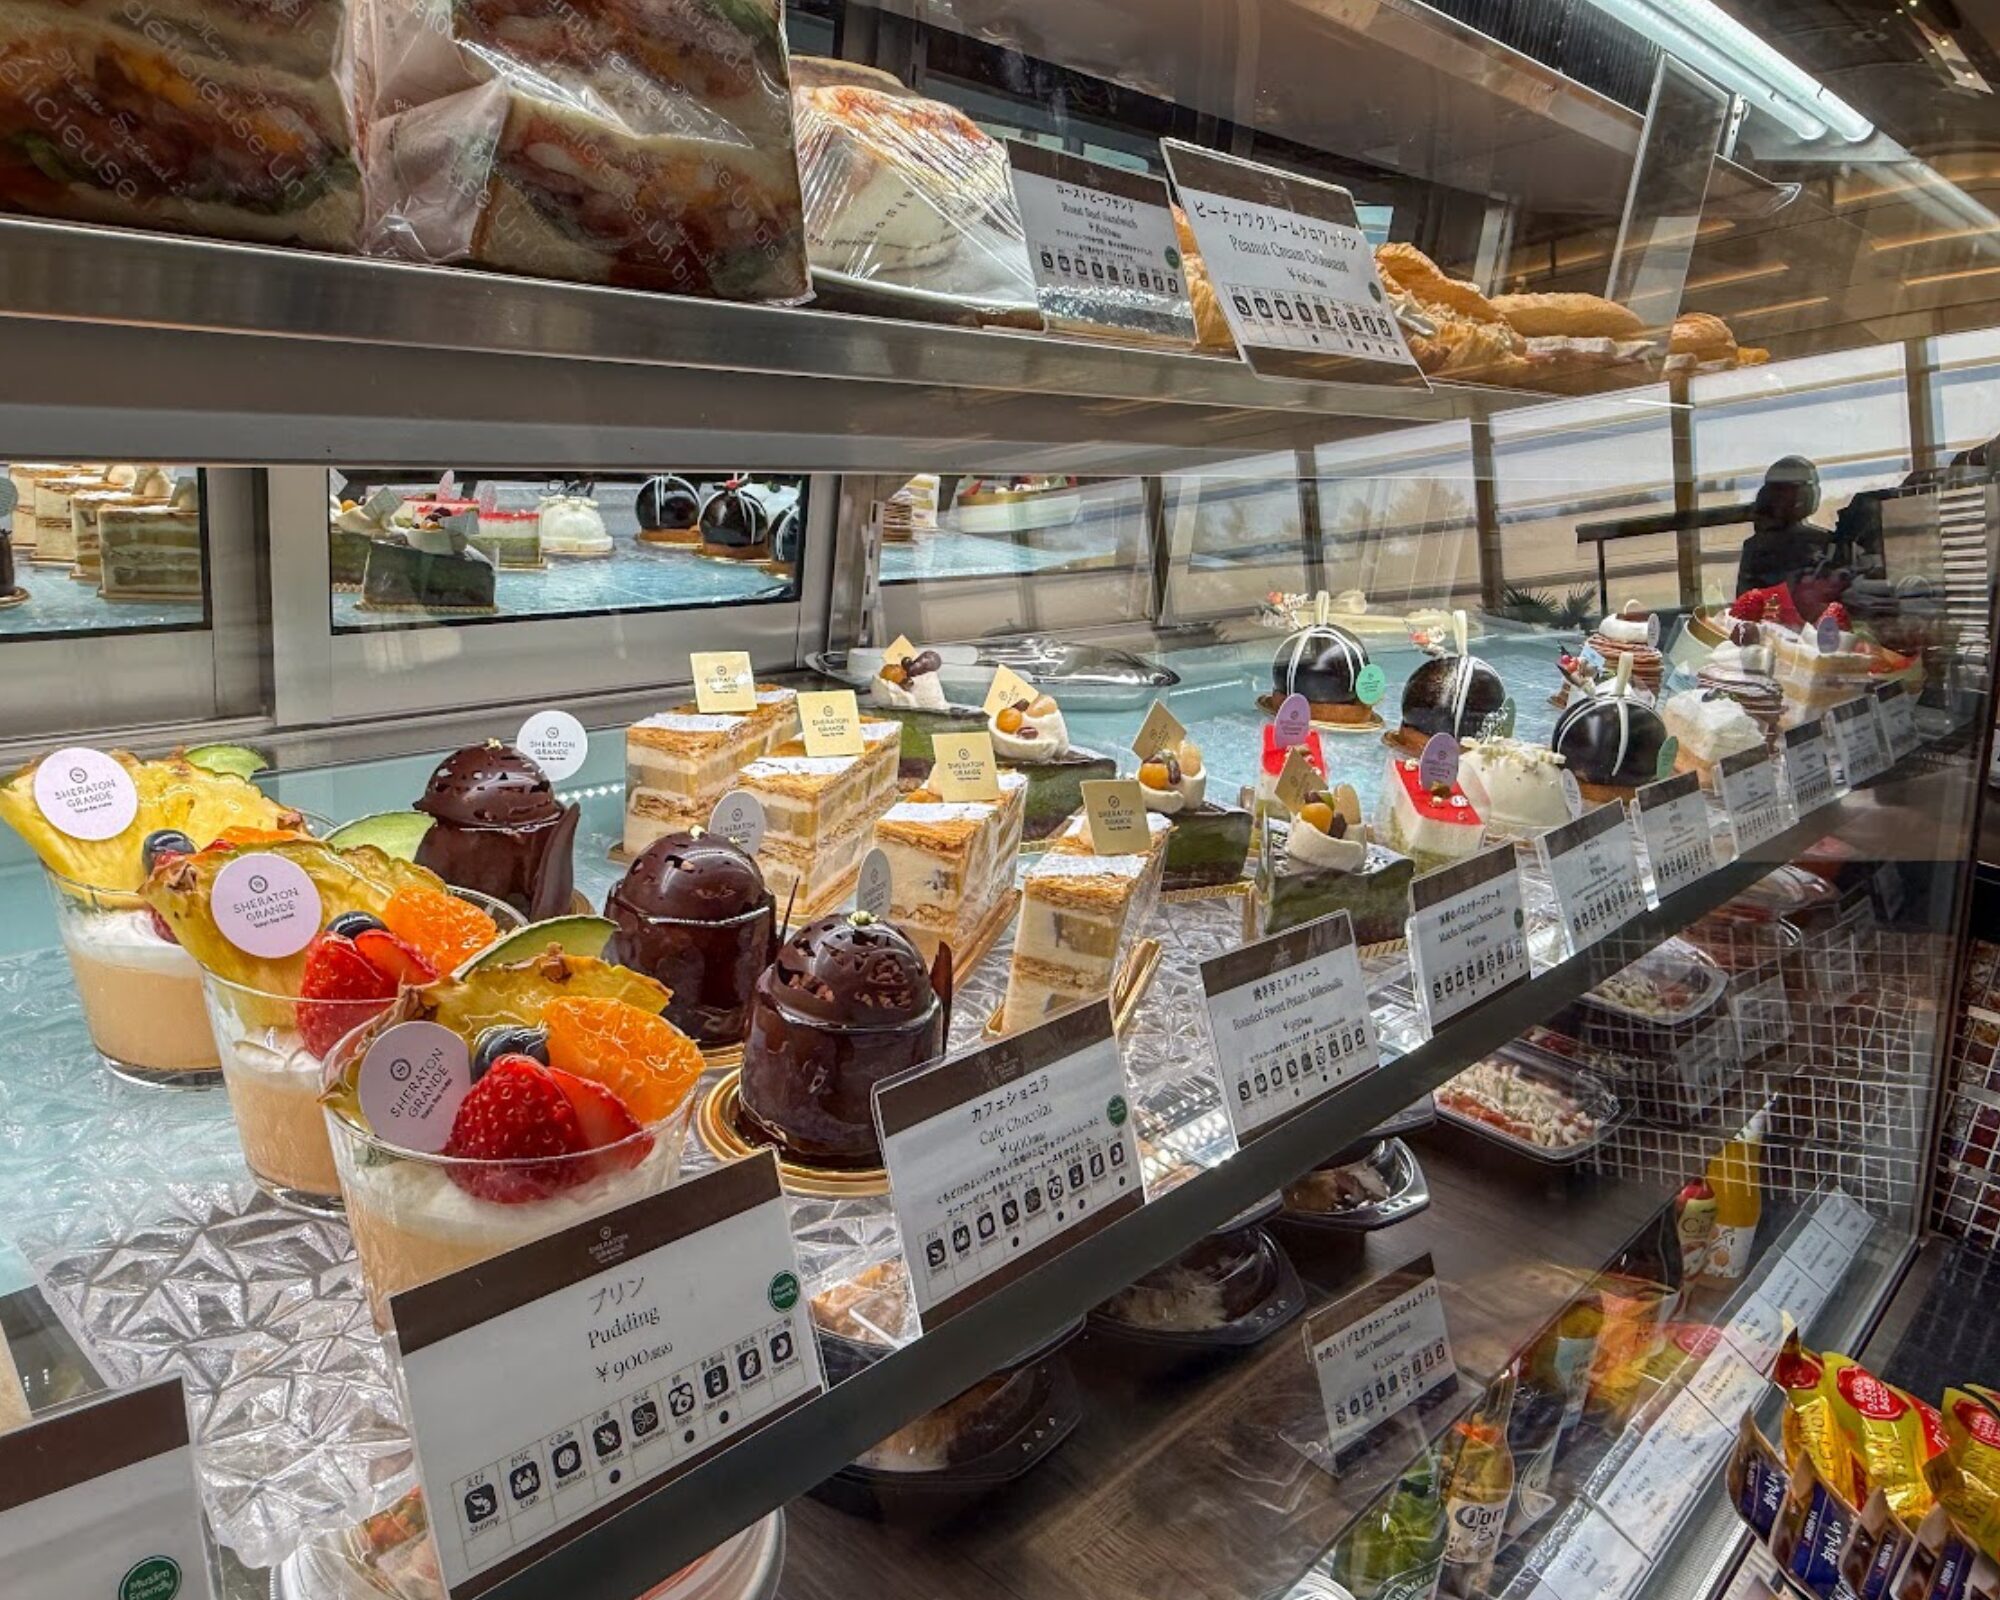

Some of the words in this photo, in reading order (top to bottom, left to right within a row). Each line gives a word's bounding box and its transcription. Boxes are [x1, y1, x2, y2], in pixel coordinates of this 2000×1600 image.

[54, 778, 117, 801] SHERATON
[65, 790, 114, 808] GRANDE
[232, 886, 300, 914] SHERATON
[246, 900, 296, 922] GRANDE
[390, 1047, 445, 1118] SHERATON
[408, 1063, 450, 1118] GRANDE
[971, 1074, 1049, 1124] カフェショコラ
[1006, 1102, 1053, 1134] Chocolat
[587, 1276, 645, 1315] プリン
[587, 1306, 661, 1349] Pudding
[519, 1494, 540, 1509] Crab
[127, 1579, 175, 1600] Friendly
[128, 1568, 170, 1592] Muslim
